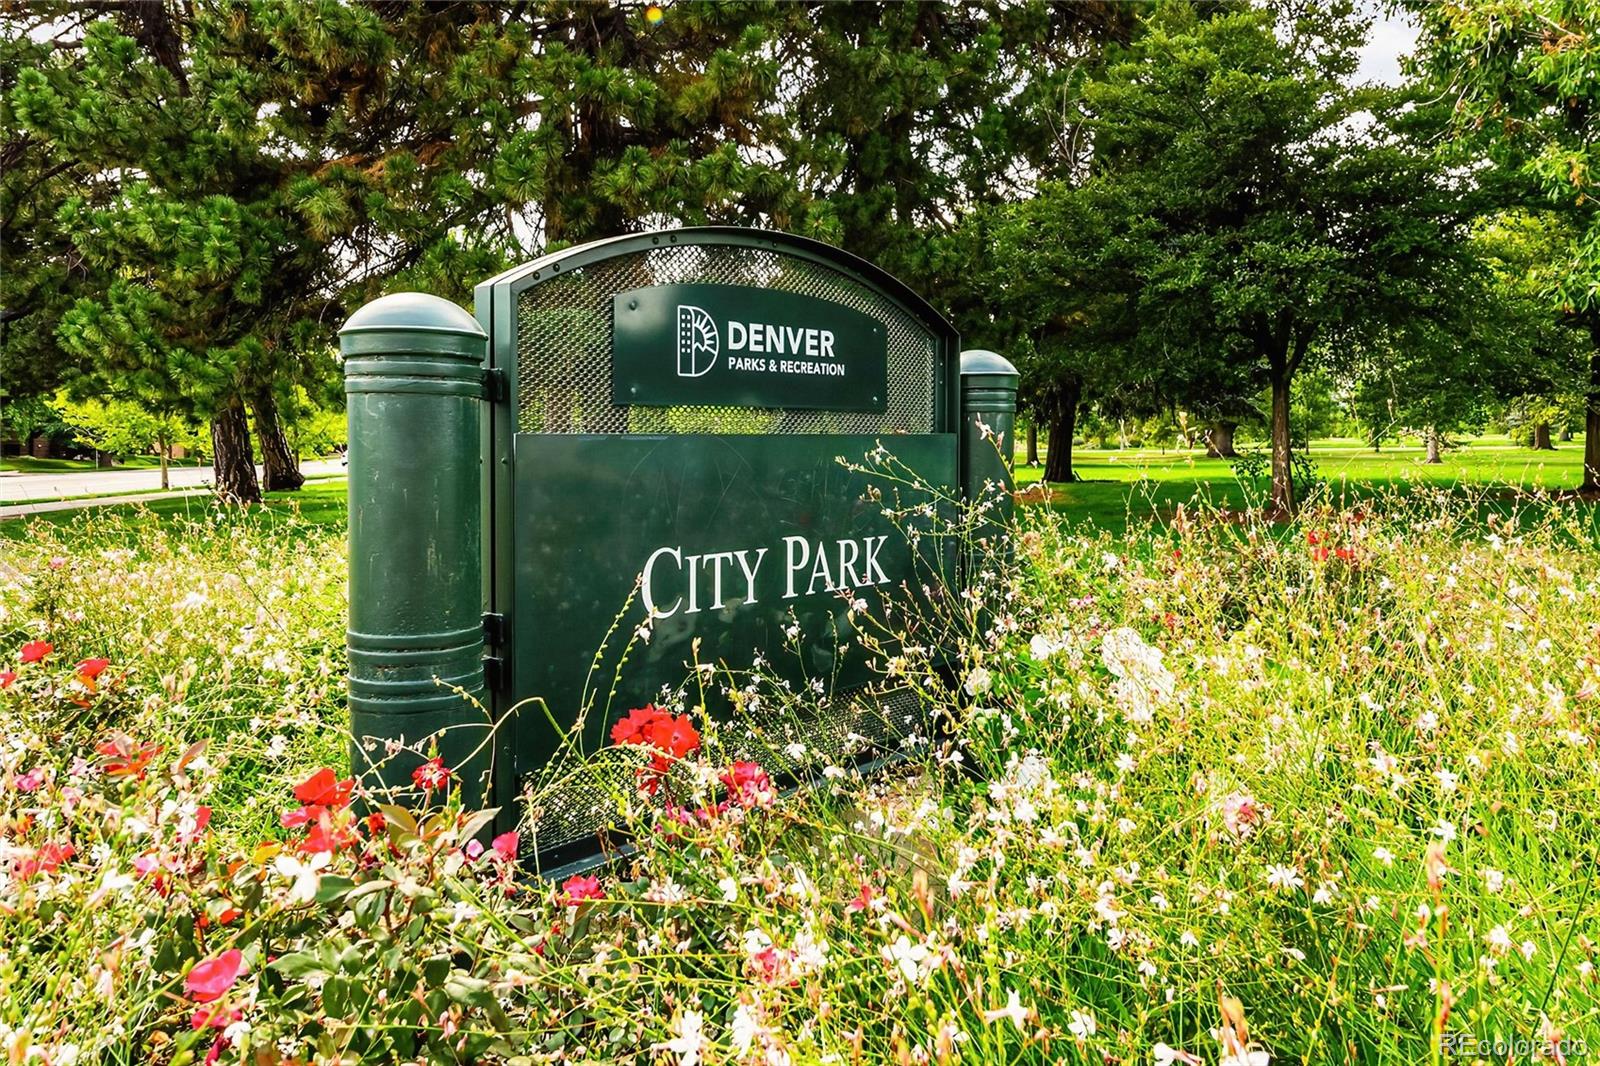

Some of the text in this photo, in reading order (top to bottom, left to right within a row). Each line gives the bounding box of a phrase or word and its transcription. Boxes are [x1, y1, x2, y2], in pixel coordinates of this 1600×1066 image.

[728, 321, 835, 358] DENVER
[728, 357, 846, 377] PARKS & RECREATION
[641, 534, 892, 620] CITY PARK
